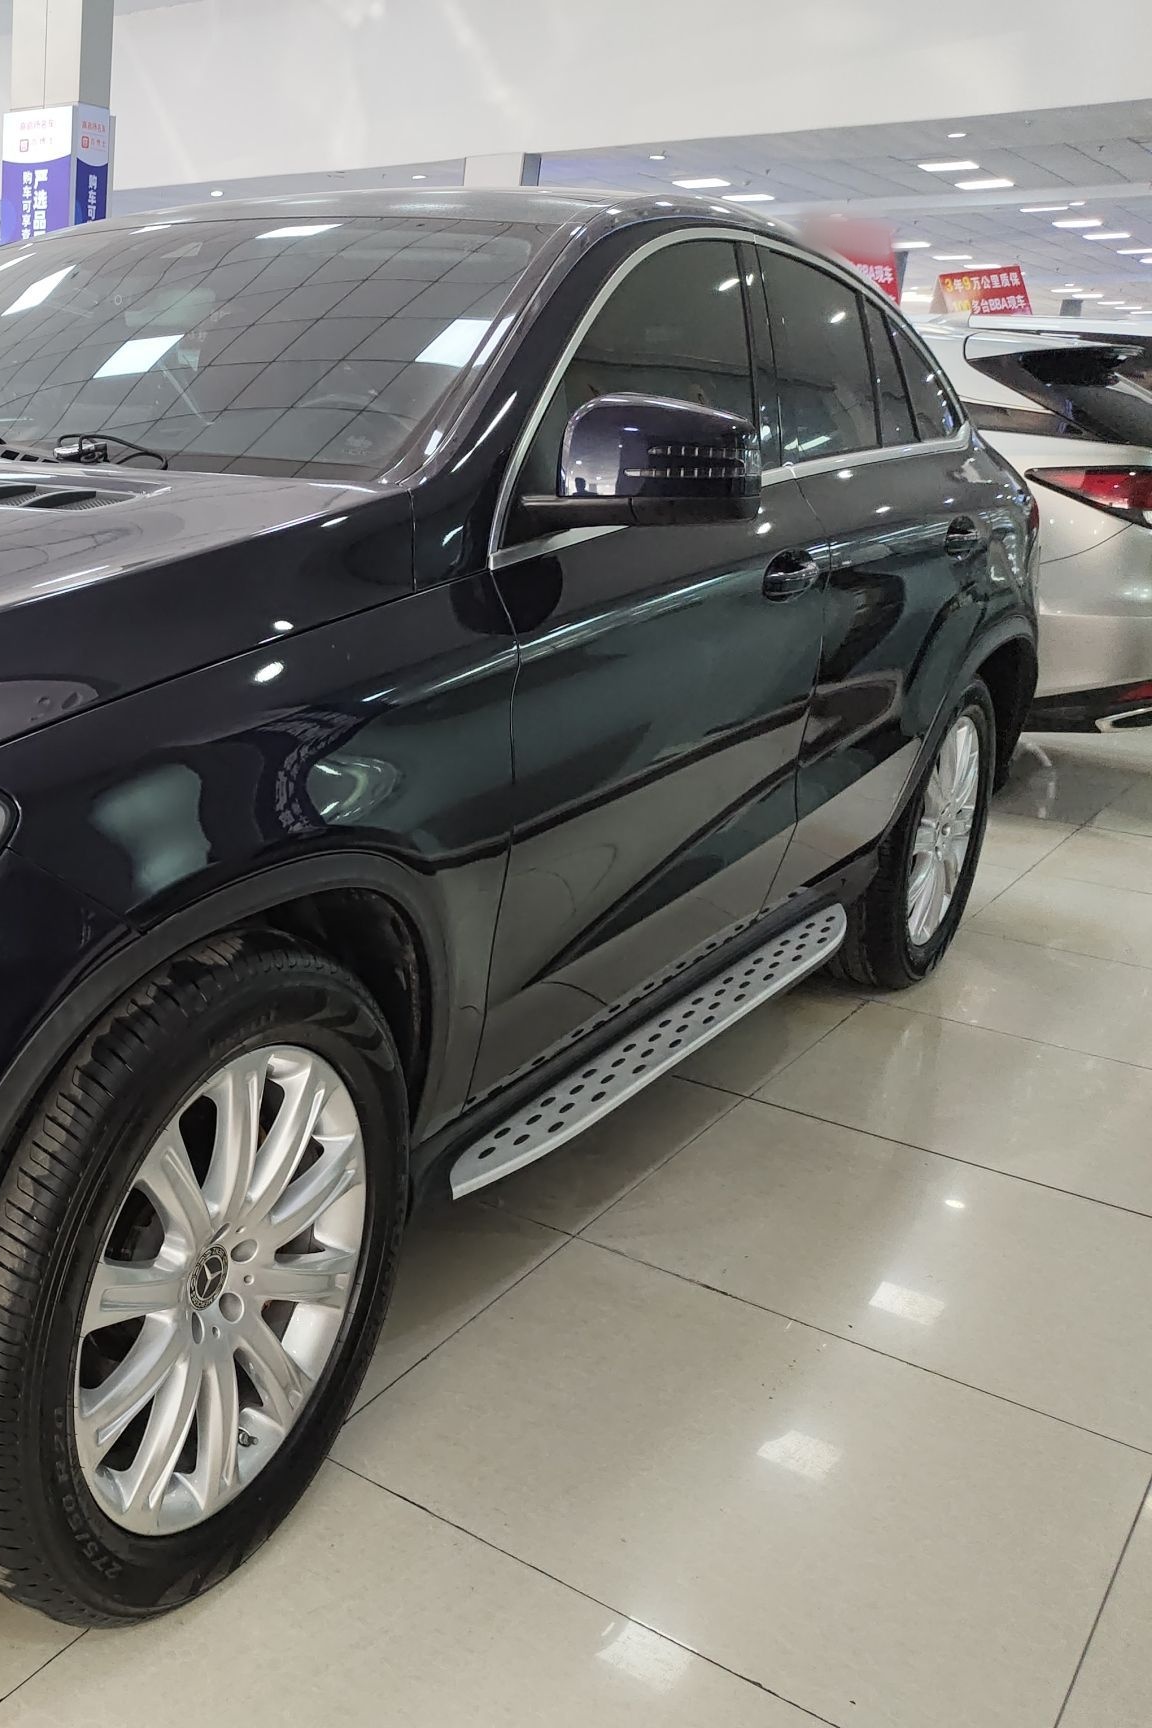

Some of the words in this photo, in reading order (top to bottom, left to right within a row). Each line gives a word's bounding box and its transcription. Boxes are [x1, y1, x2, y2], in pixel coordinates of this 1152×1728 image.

[32, 169, 49, 237] 严选品
[87, 174, 98, 224] 购车可
[944, 271, 1021, 293] 3年9万公里质保
